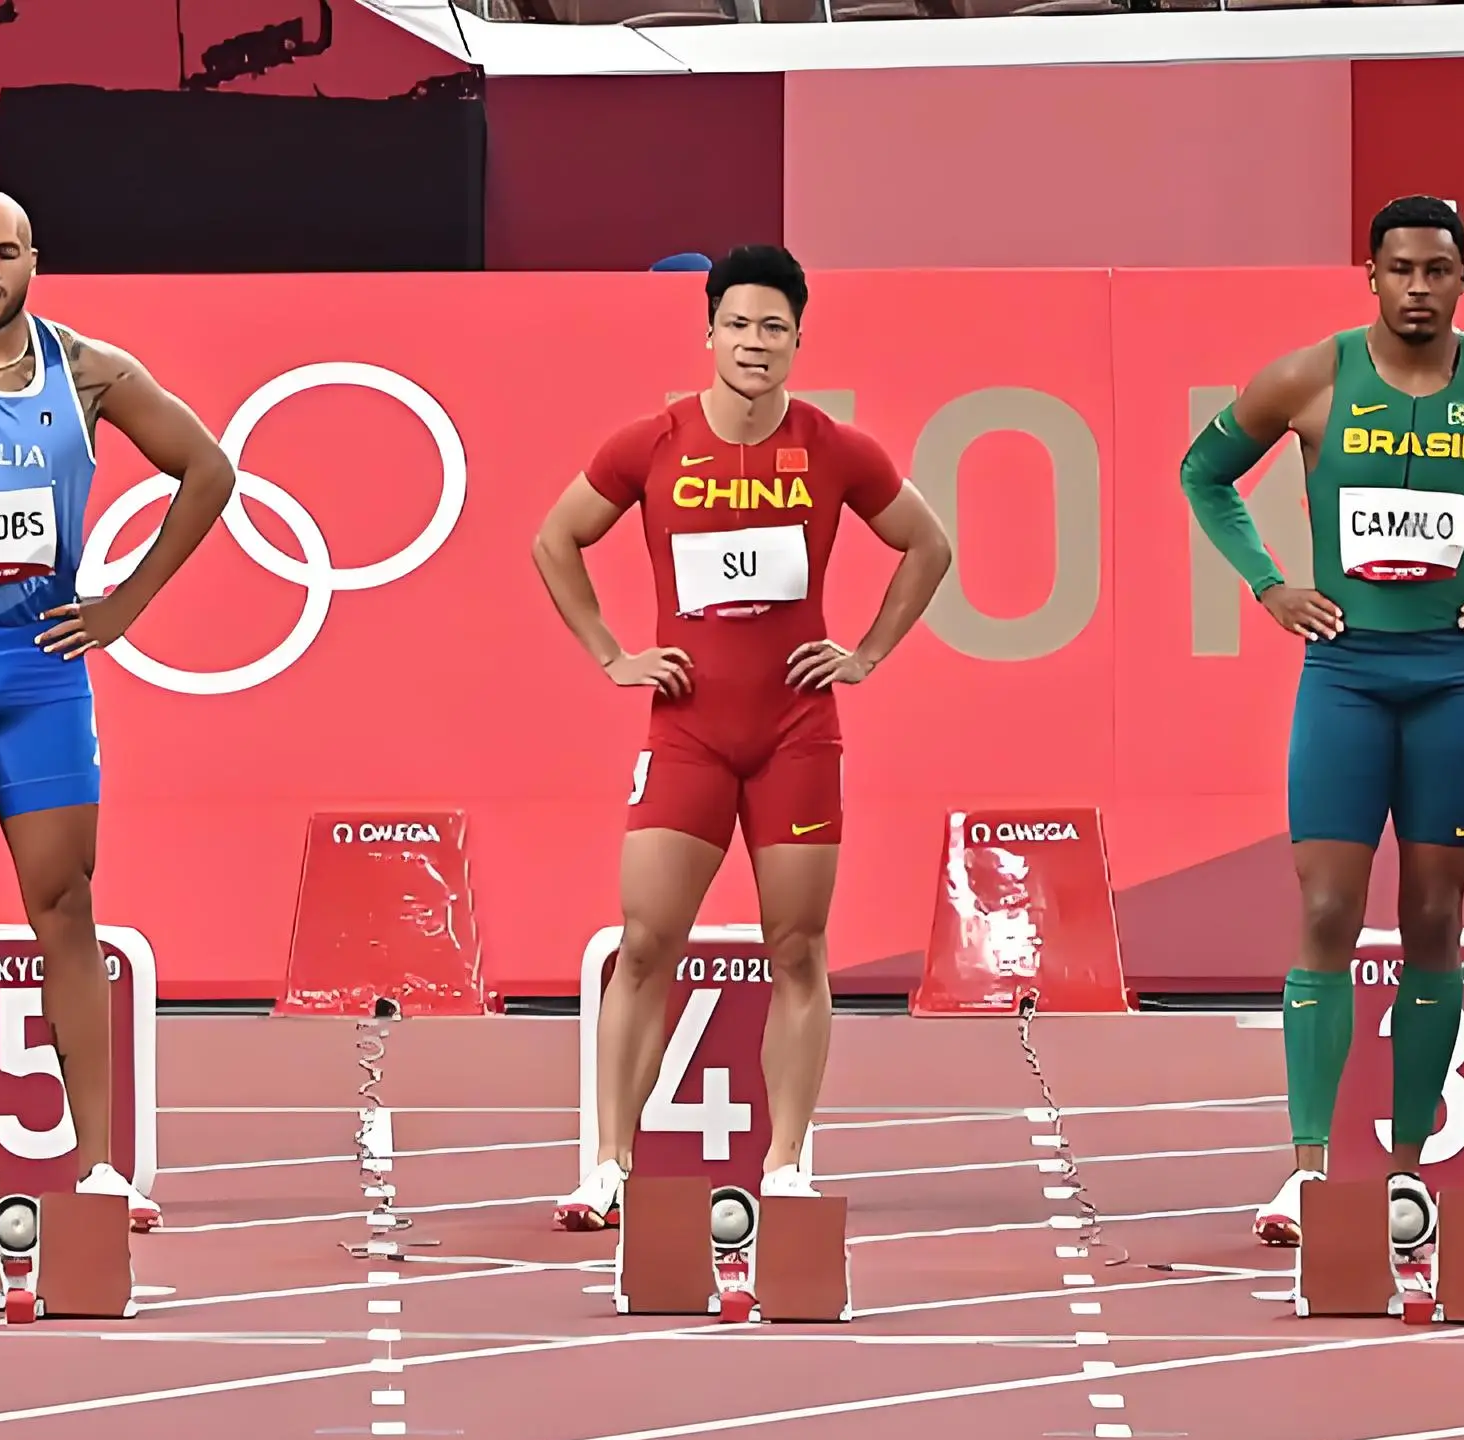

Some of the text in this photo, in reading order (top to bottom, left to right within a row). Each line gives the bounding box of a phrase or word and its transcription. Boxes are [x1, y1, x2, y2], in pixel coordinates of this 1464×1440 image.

[673, 476, 813, 509] CHINA
[723, 550, 757, 579] SU
[639, 988, 752, 1161] 4
